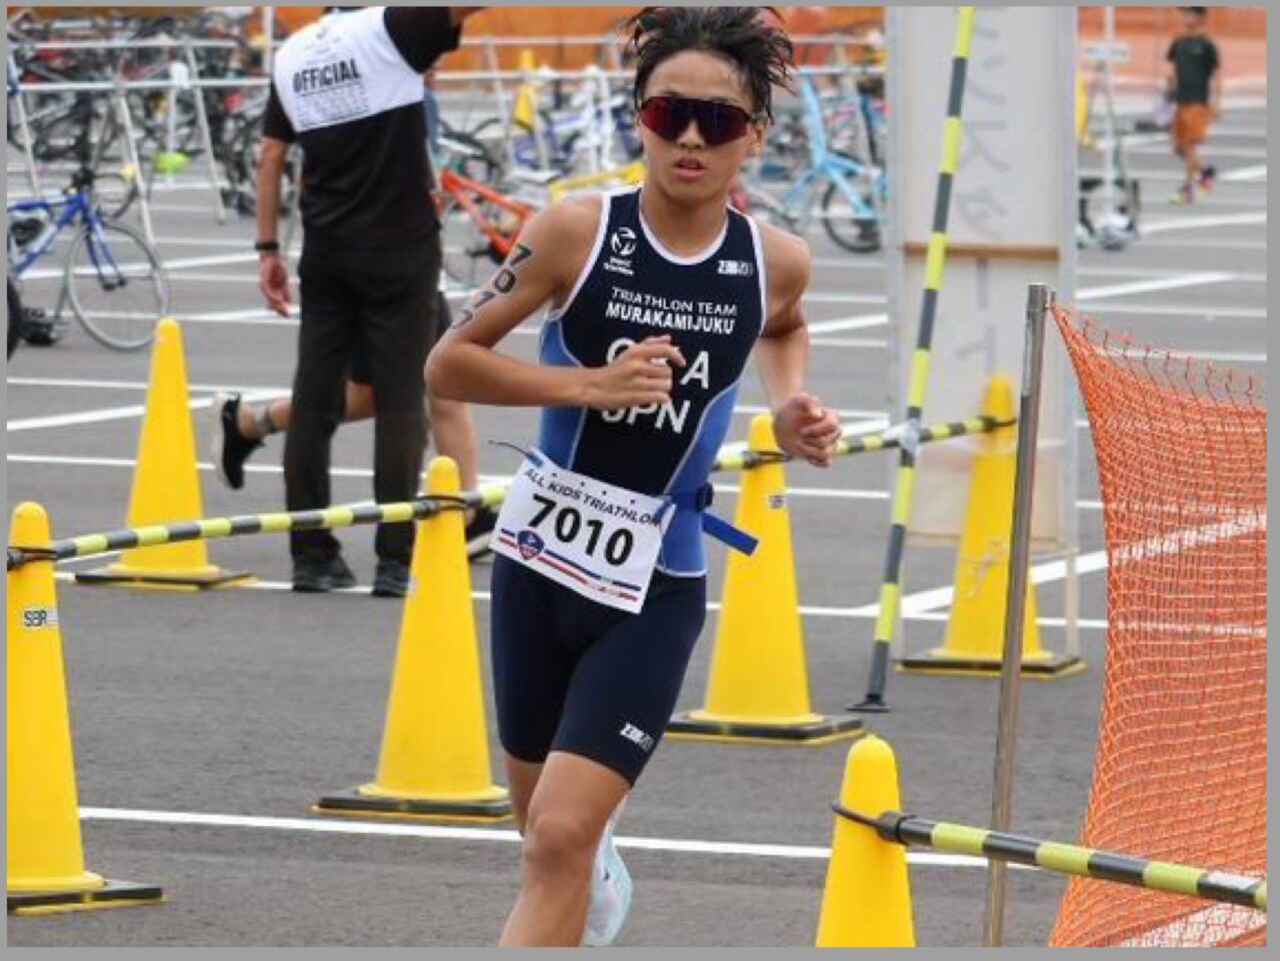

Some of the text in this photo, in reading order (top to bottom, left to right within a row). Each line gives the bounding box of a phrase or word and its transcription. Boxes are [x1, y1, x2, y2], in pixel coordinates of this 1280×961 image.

[292, 58, 361, 93] OFFICIAL
[605, 301, 735, 335] MURAKAMIJUKU
[611, 286, 737, 317] TRIATHLON TEAM
[524, 468, 545, 488] ALL
[547, 481, 580, 501] KIDS
[528, 493, 634, 567] 7010
